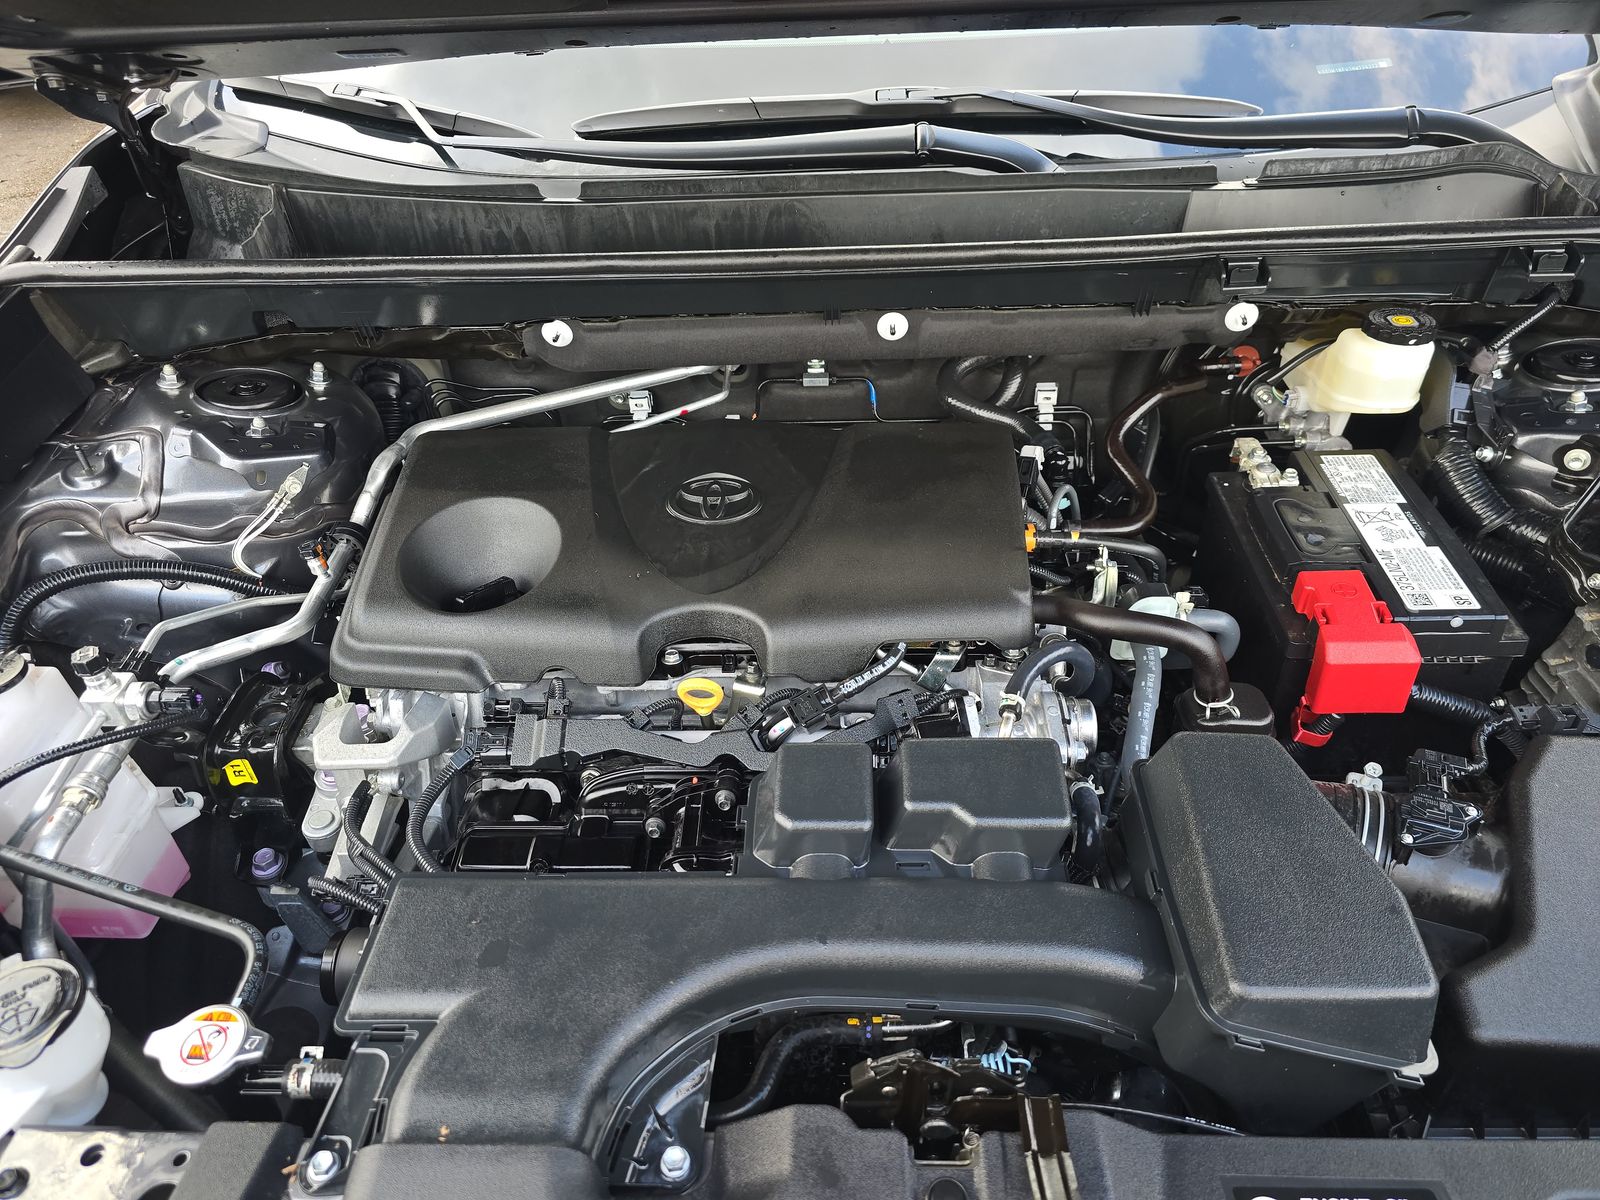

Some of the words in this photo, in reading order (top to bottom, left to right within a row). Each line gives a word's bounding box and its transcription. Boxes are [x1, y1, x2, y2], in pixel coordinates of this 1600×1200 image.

[1375, 549, 1415, 591] 375LN2-MF
[1453, 595, 1473, 606] SP
[230, 764, 246, 777] R1
